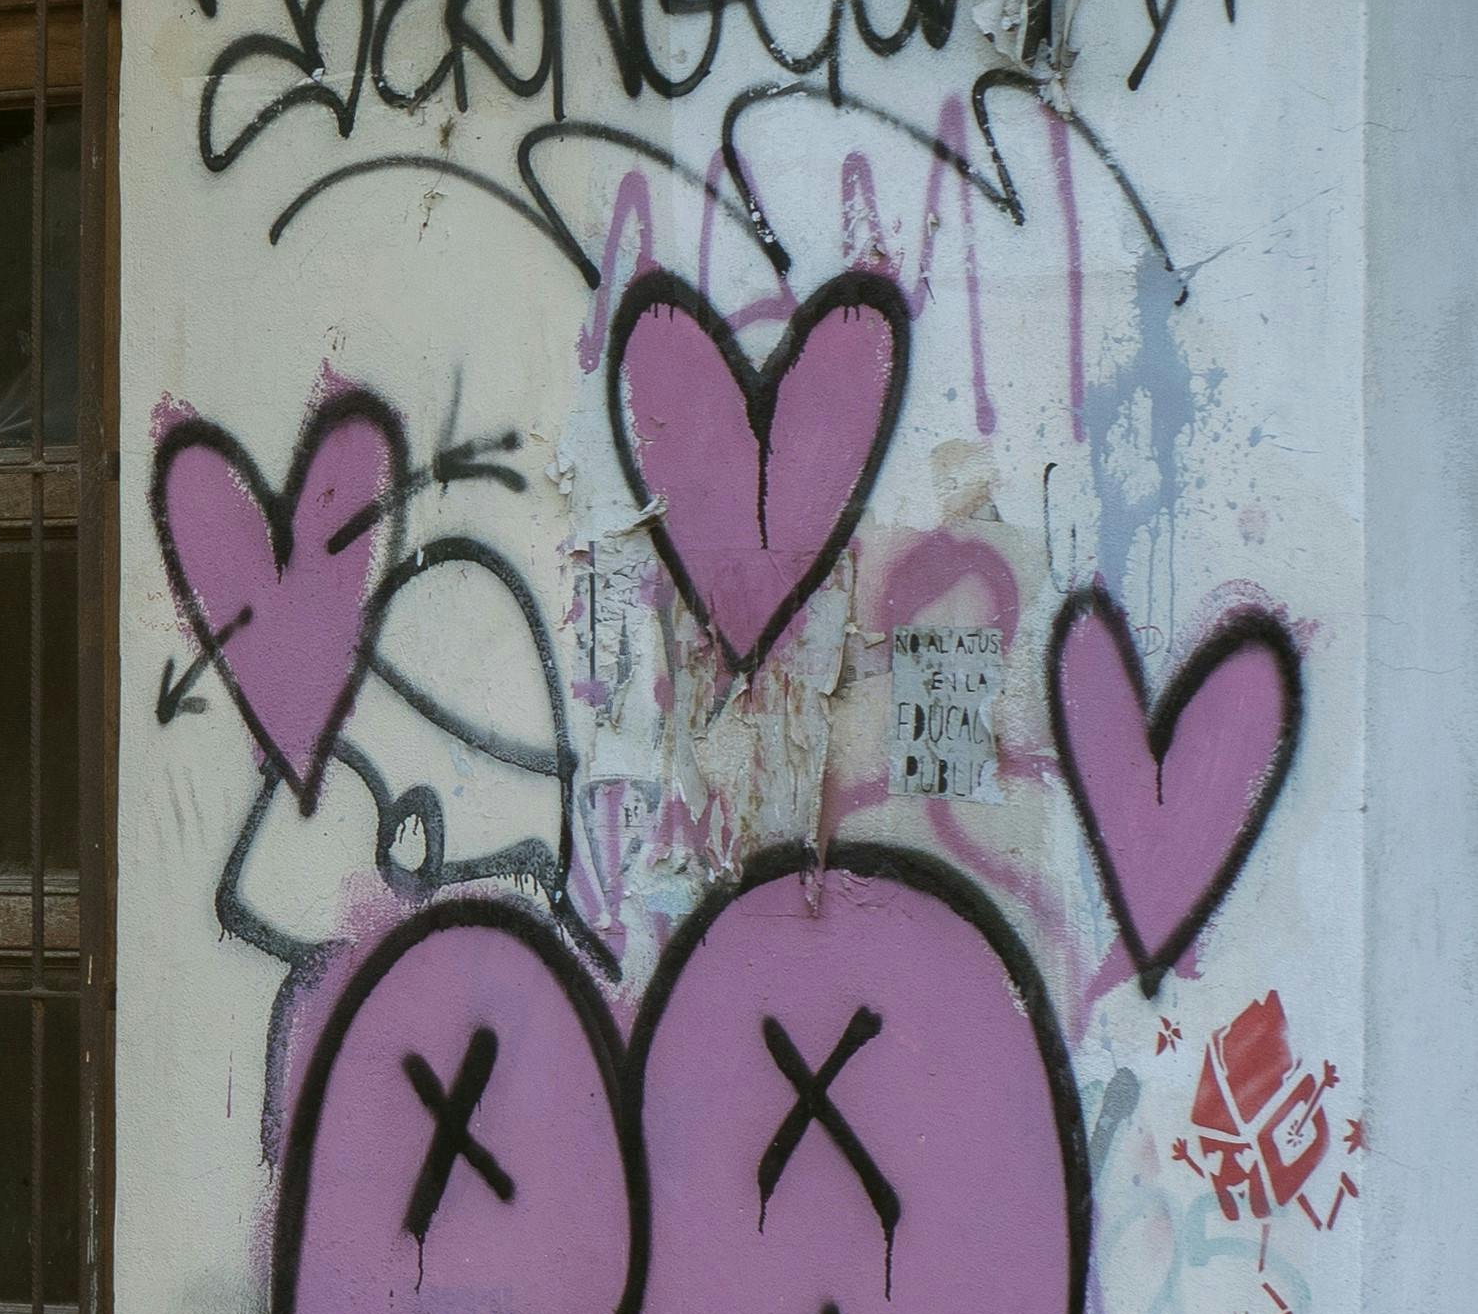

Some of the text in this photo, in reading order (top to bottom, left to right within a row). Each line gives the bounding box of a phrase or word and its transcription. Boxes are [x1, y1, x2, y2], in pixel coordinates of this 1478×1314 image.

[895, 634, 920, 654] NO
[927, 635, 948, 654] AL
[931, 671, 987, 693] EN LA
[898, 701, 992, 745] EDUCAC
